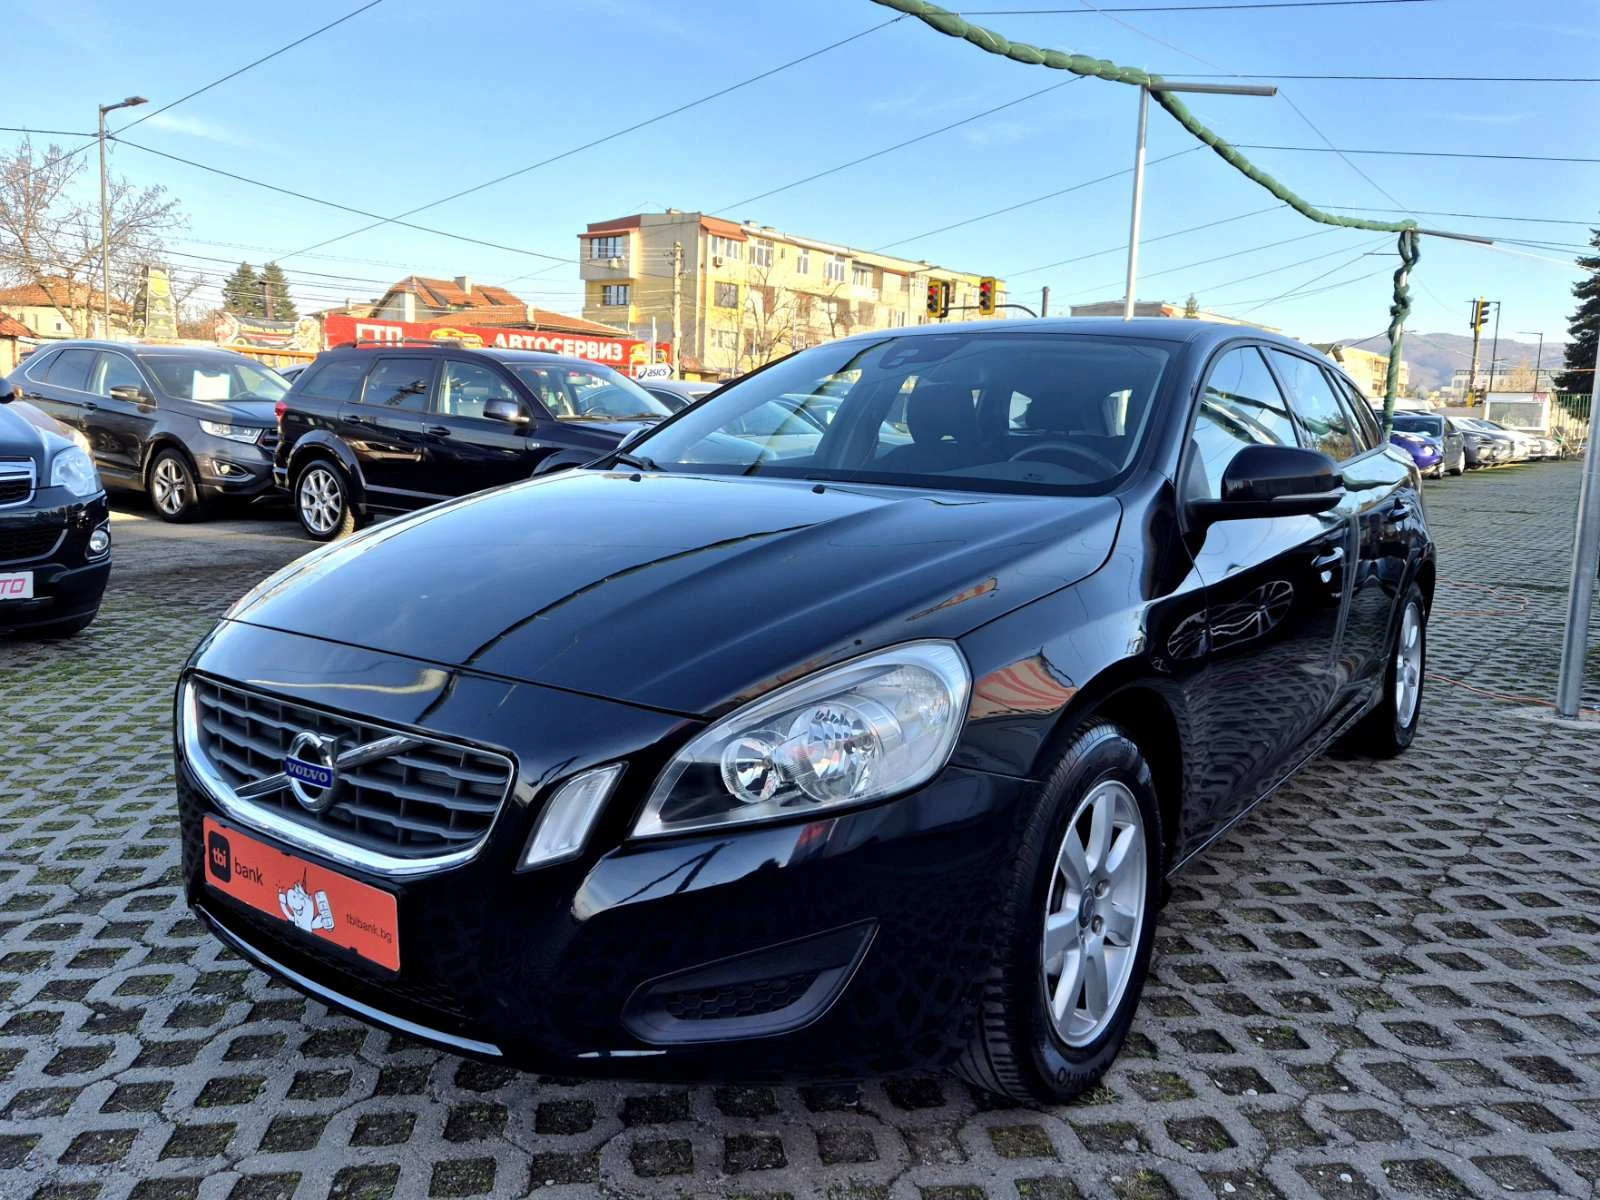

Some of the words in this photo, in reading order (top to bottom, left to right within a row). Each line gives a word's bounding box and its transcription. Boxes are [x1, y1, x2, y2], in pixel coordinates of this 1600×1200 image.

[495, 333, 623, 361] АВТОСЕРВИЗ
[287, 761, 329, 783] VOLVO
[212, 847, 227, 869] tbi
[234, 855, 264, 886] bank
[346, 911, 392, 944] tbibank.bg
